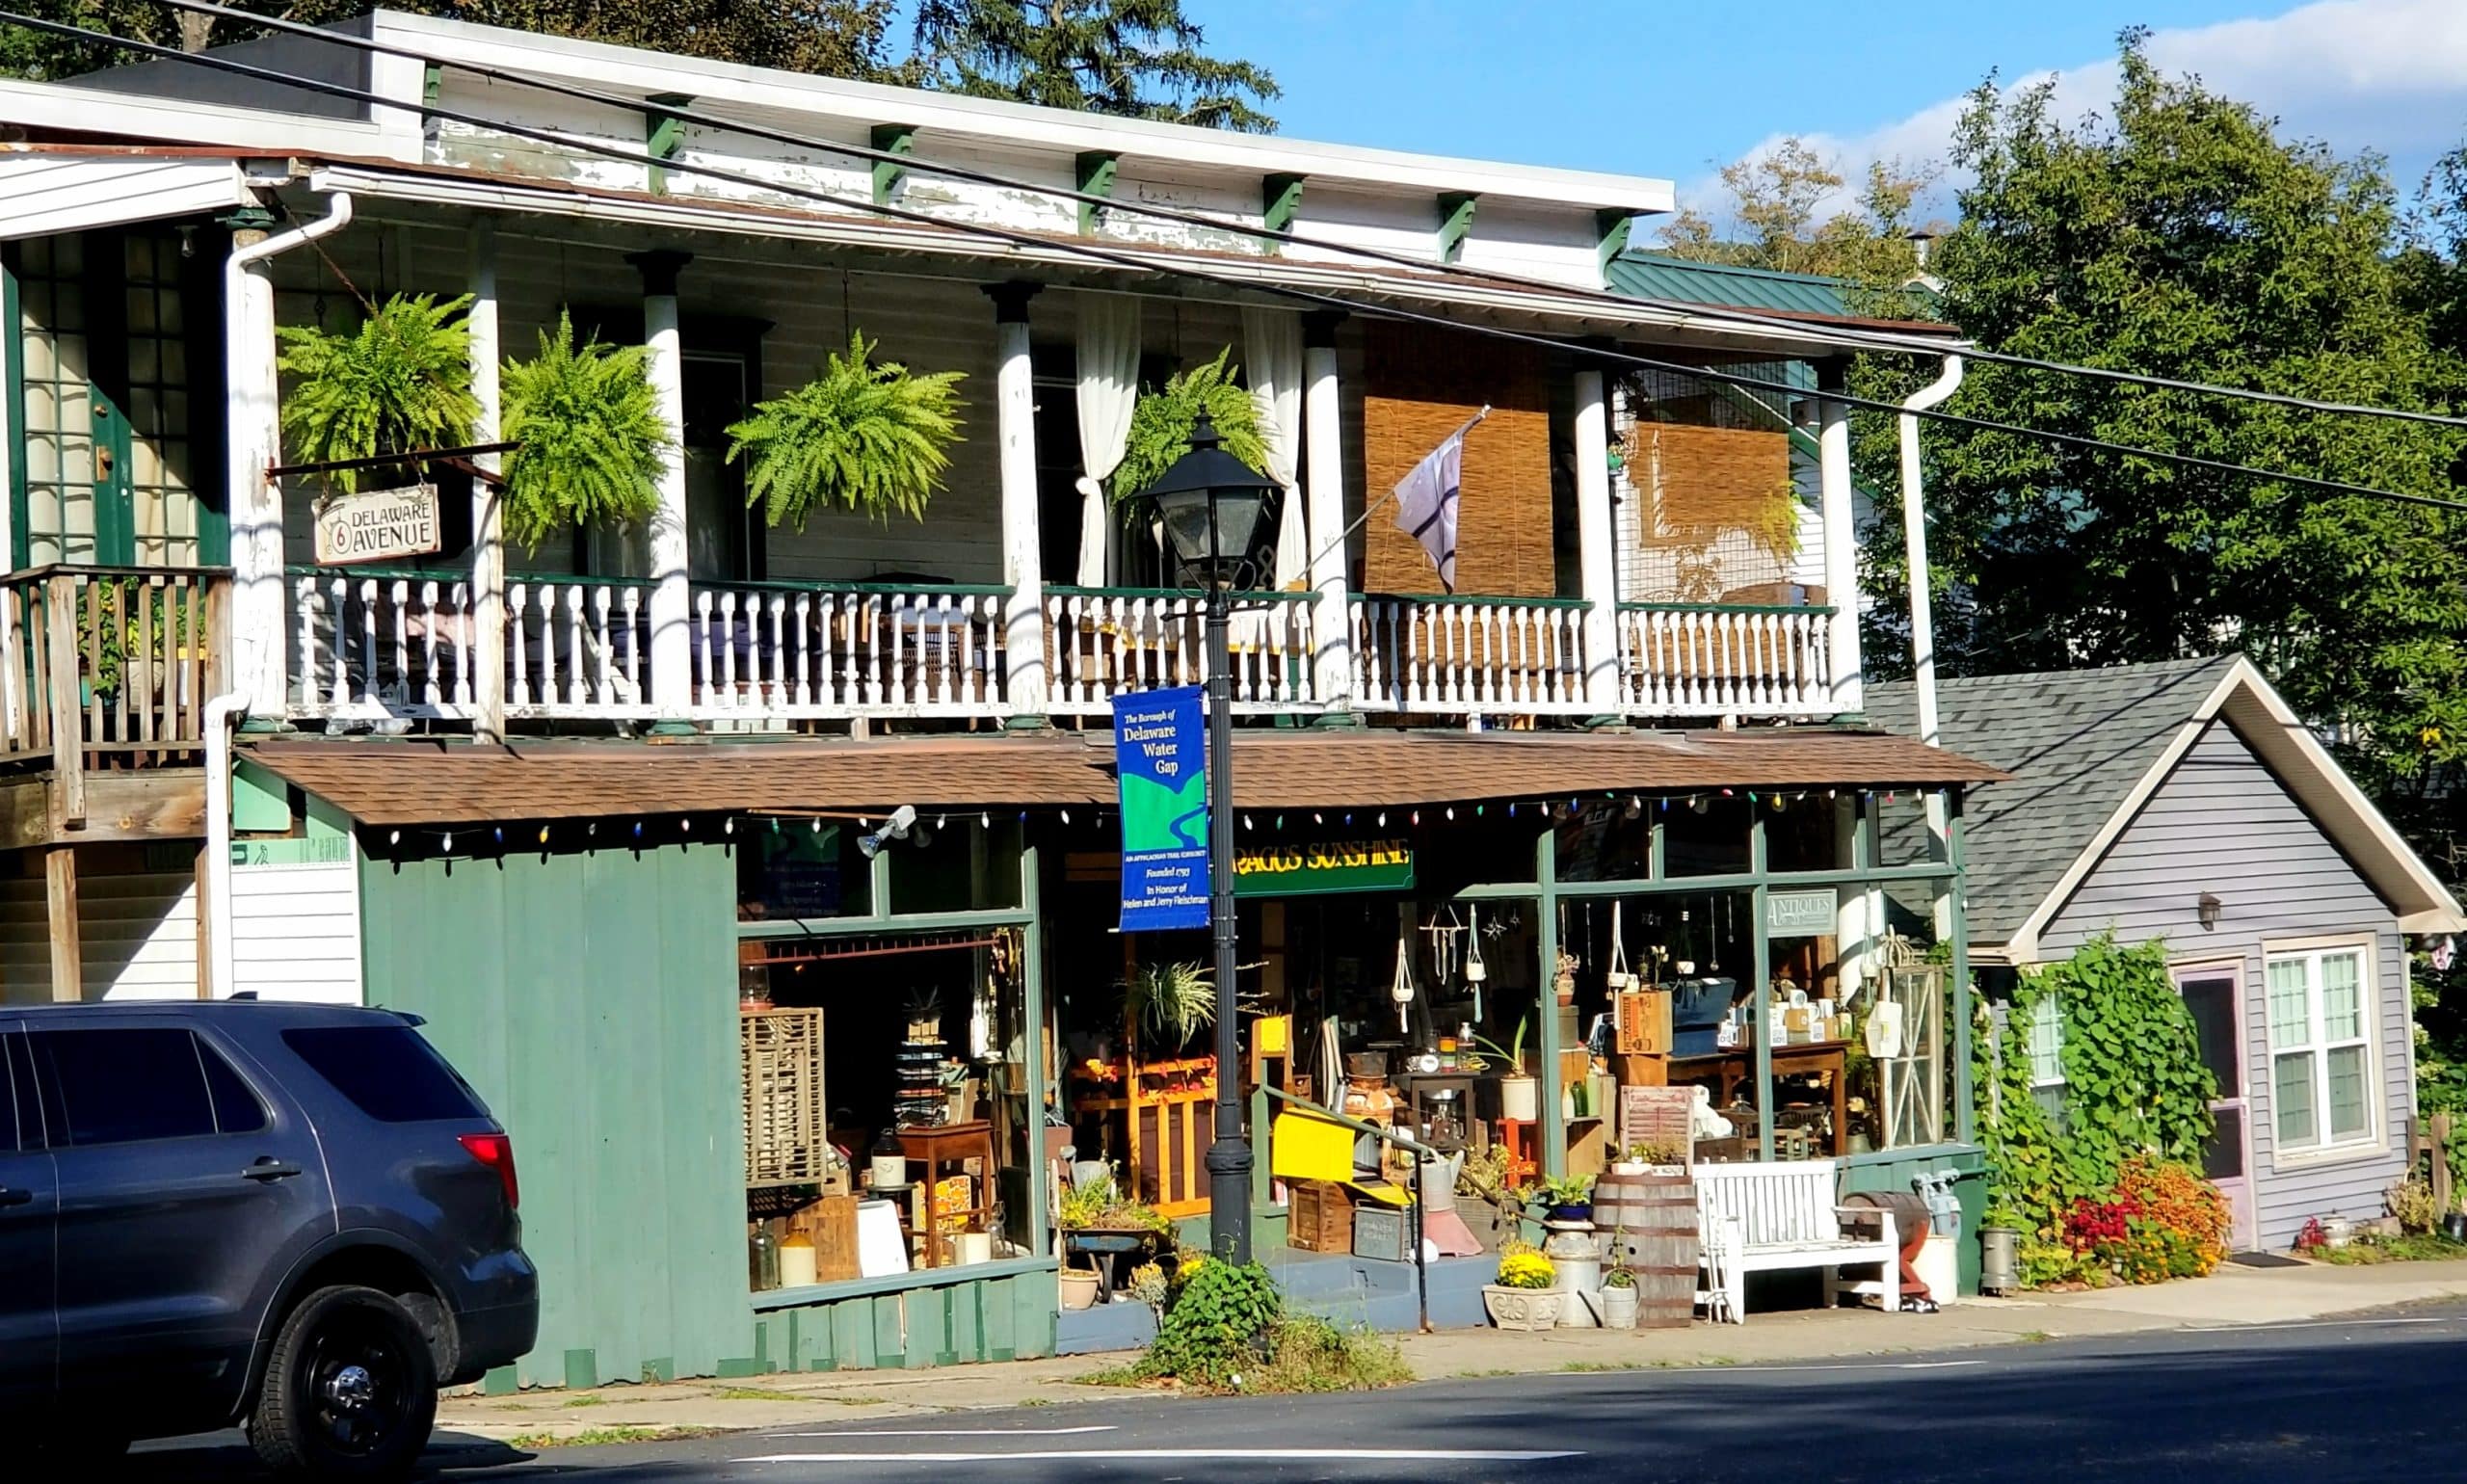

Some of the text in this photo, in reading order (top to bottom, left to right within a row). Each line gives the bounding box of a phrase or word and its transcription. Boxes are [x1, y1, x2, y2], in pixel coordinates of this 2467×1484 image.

[352, 502, 431, 528] DELAWARE
[336, 527, 346, 546] 6
[353, 521, 432, 552] AVENUE
[1125, 709, 1176, 724] The Borough of
[1124, 726, 1176, 742] Delaware
[1143, 743, 1178, 757] Water
[1155, 759, 1179, 777] Gap
[1308, 838, 1409, 868] SUNSHINE
[1146, 867, 1175, 878] Founded
[1155, 885, 1179, 893] Honor
[1179, 883, 1187, 892] of
[1124, 900, 1143, 909] Helen
[1144, 897, 1156, 907] and
